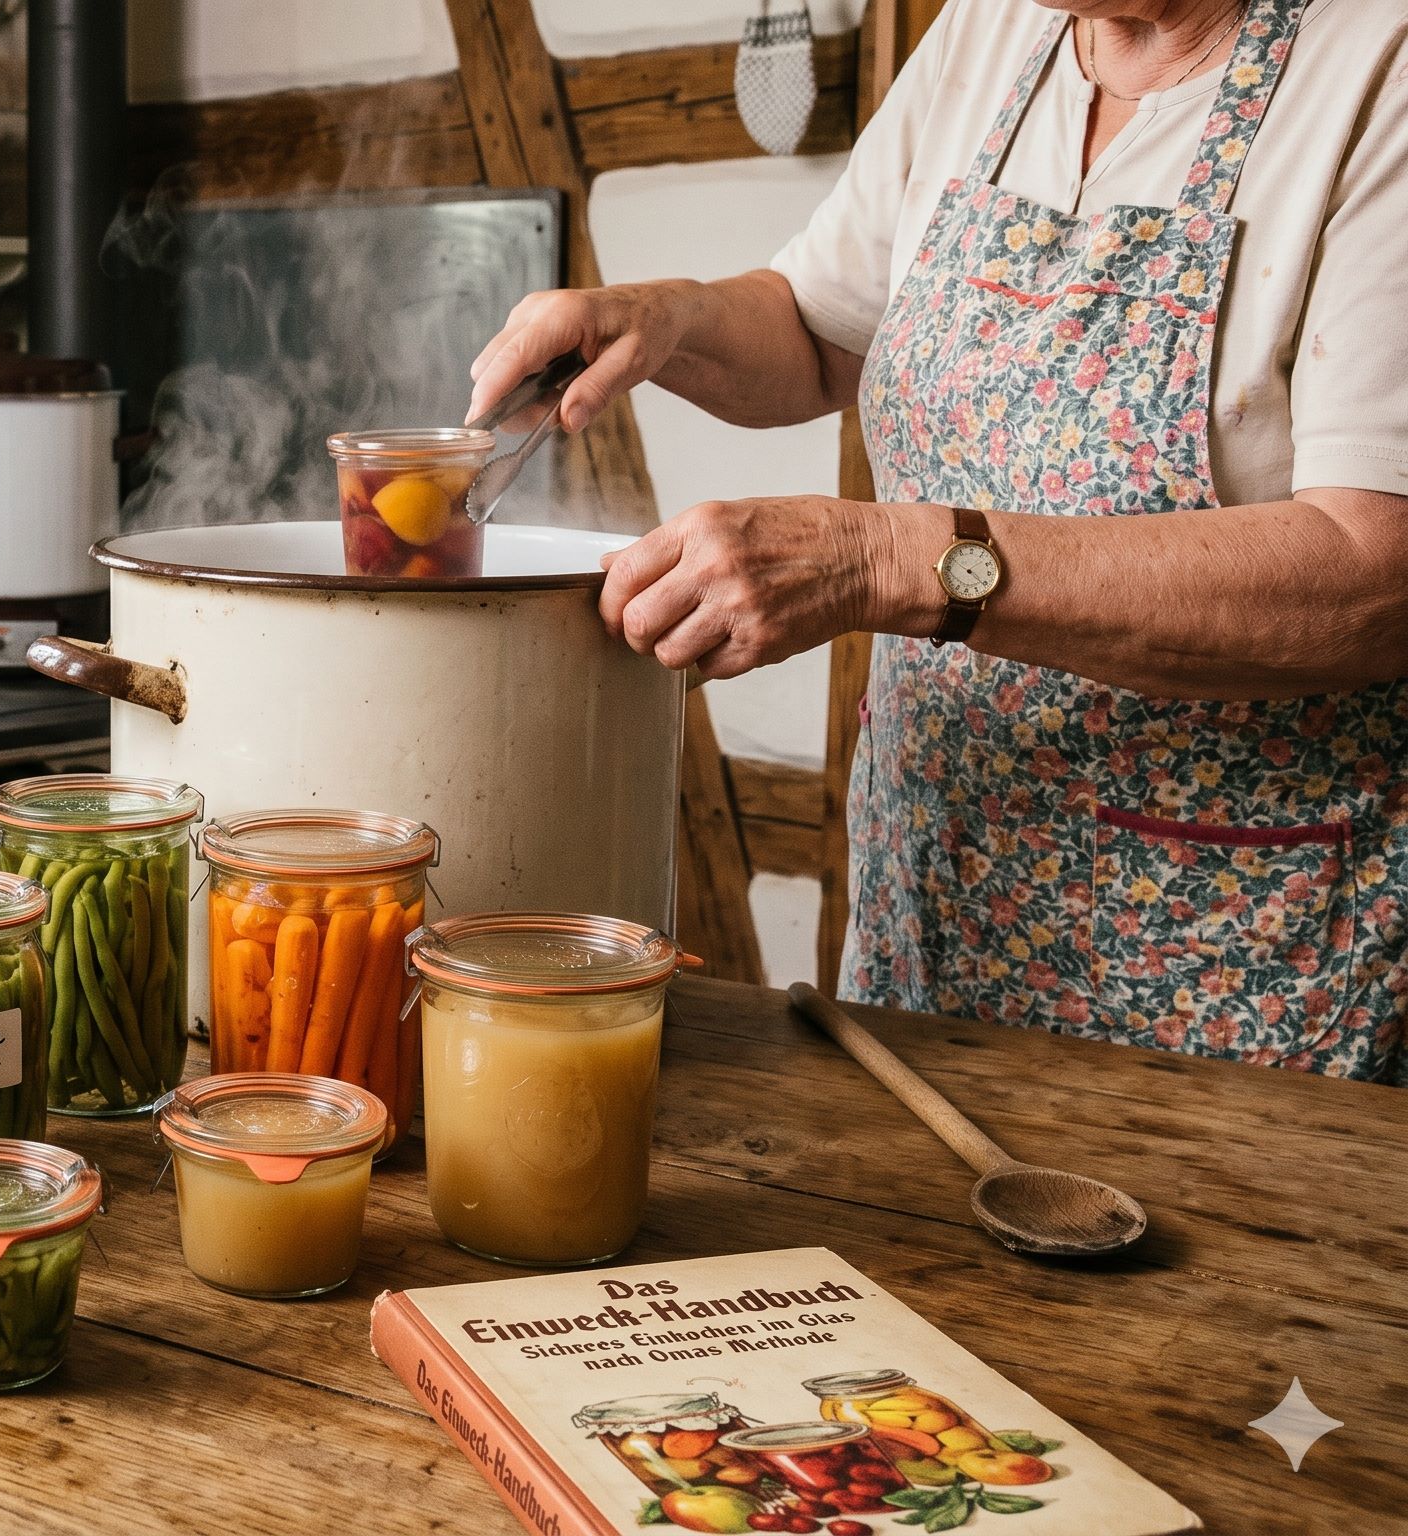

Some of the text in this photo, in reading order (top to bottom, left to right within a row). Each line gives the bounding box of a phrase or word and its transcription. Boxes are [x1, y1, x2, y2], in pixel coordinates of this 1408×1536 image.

[597, 1279, 679, 1300] Das
[461, 1280, 865, 1344] Einweck-Handbuch
[757, 1319, 795, 1332] im
[798, 1312, 856, 1327] Glas
[582, 1331, 838, 1371] nach Omas Methode
[416, 1358, 439, 1407] Das
